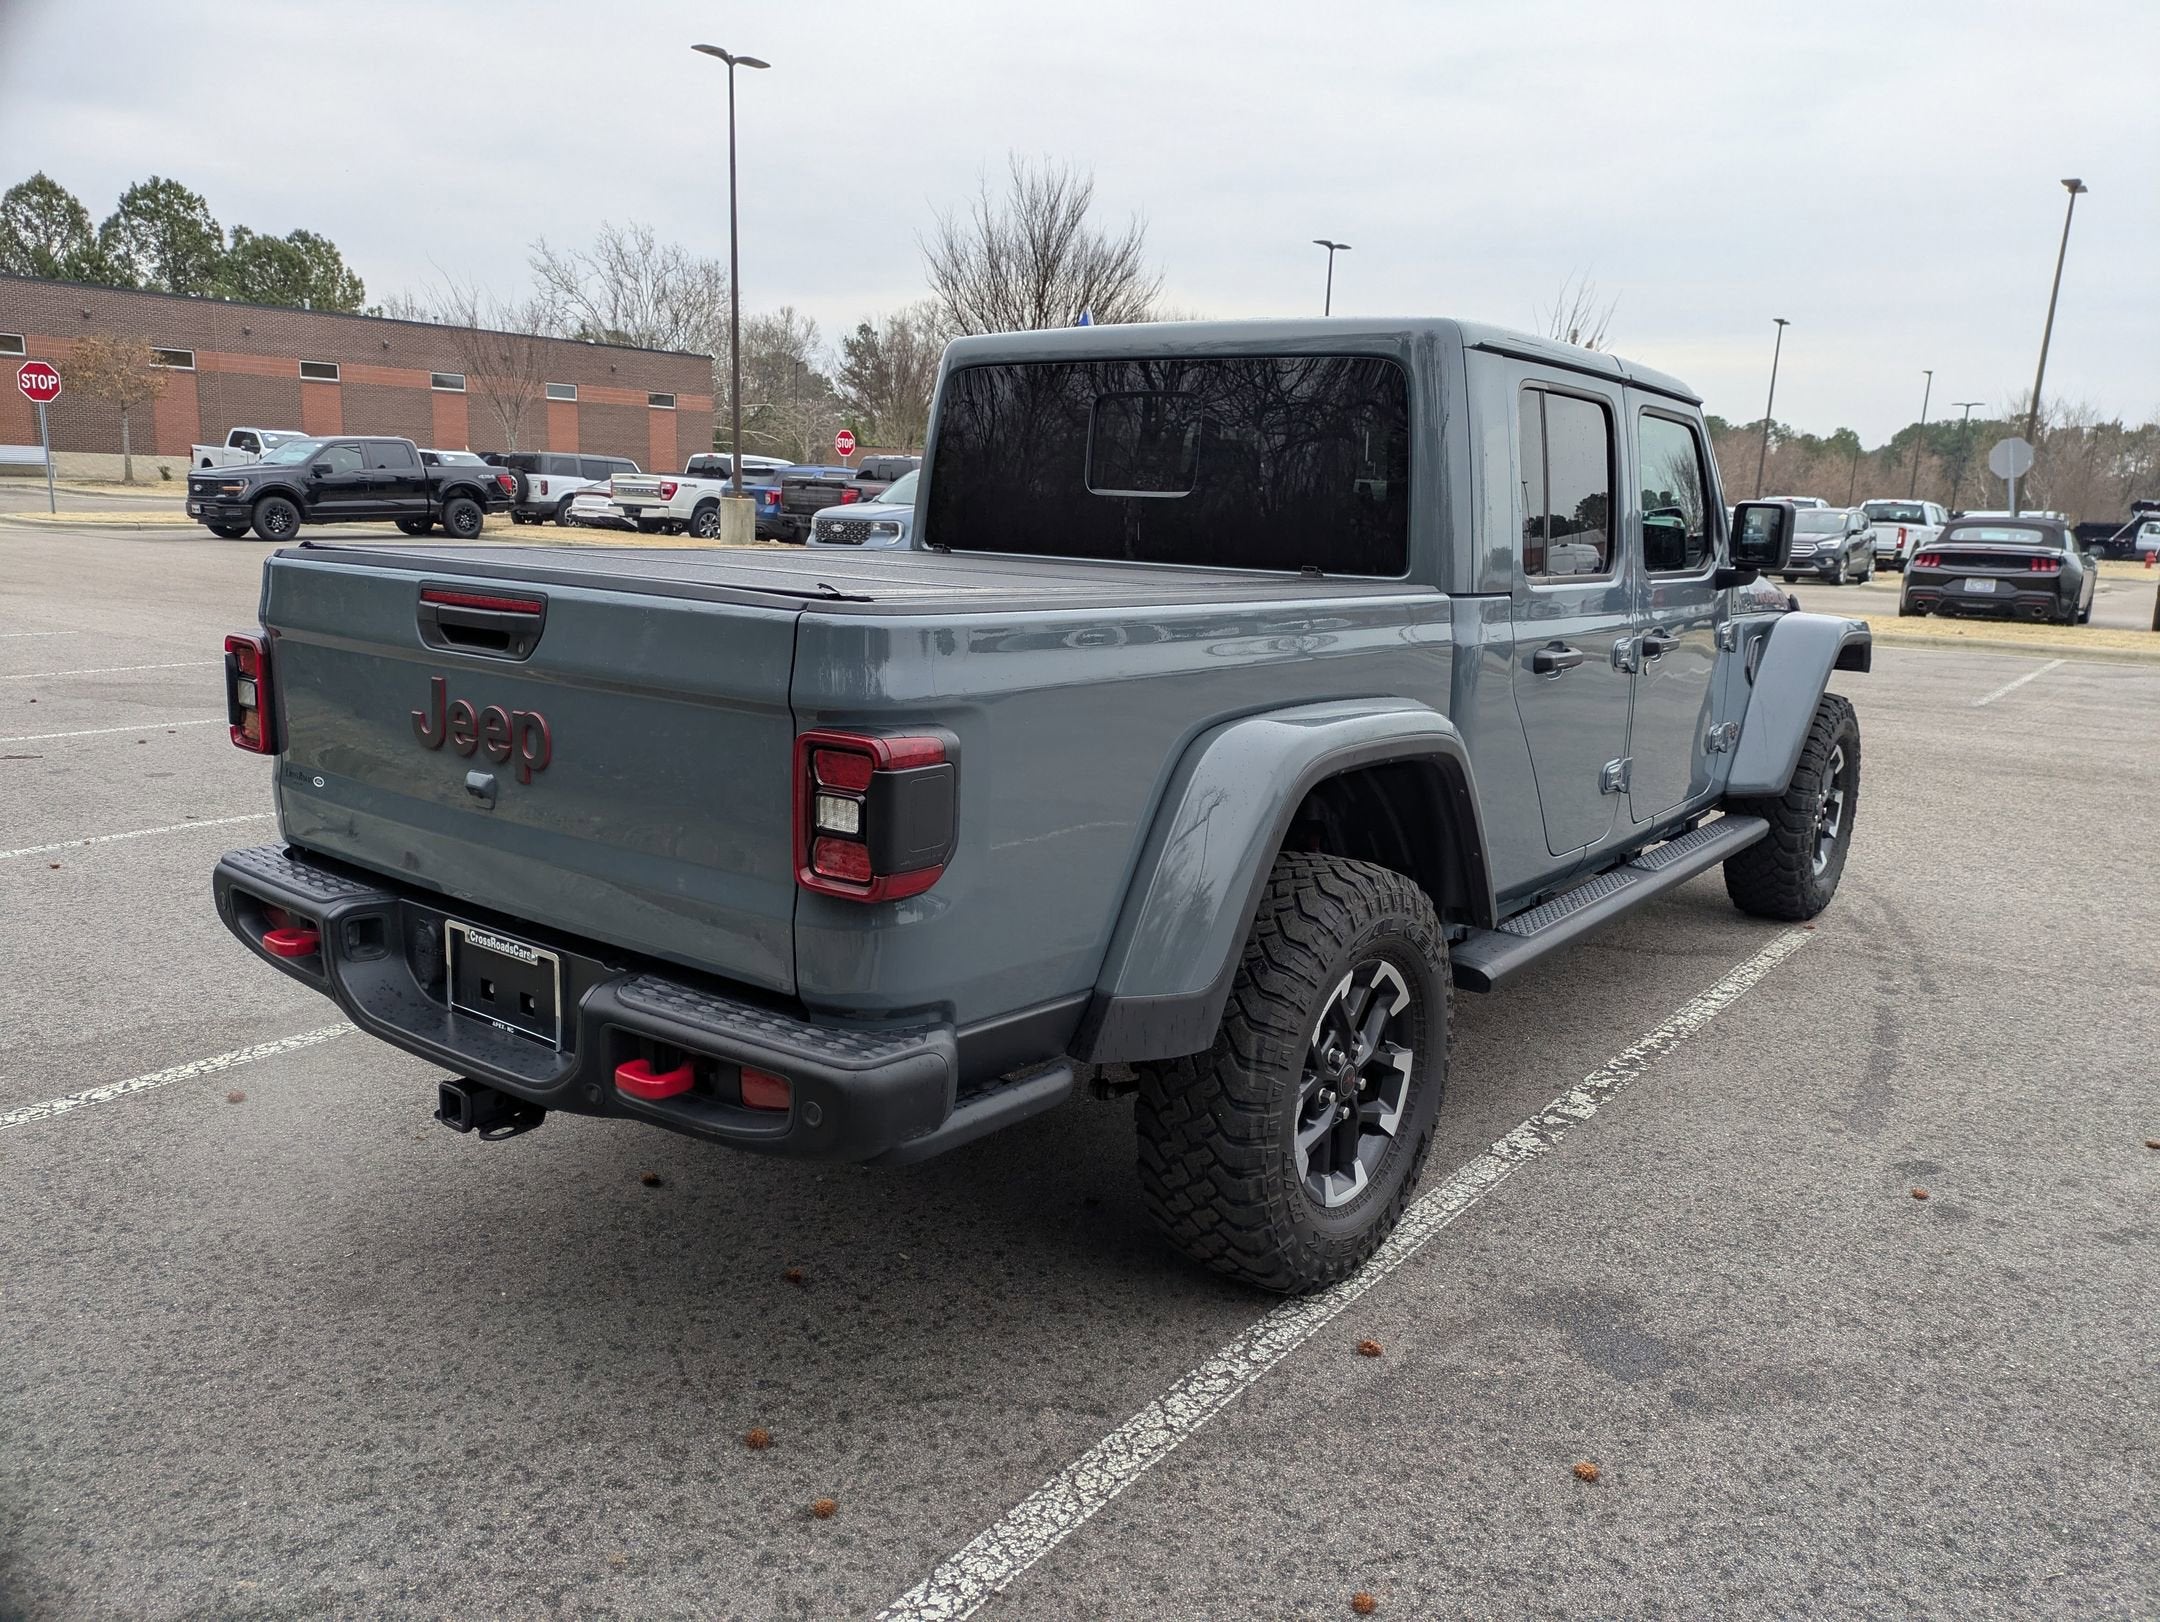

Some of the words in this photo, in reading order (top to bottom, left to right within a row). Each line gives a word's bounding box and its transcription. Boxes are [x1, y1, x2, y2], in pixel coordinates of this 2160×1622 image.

[21, 373, 58, 390] STOP
[837, 437, 854, 449] STOP
[411, 674, 552, 785] Jeep
